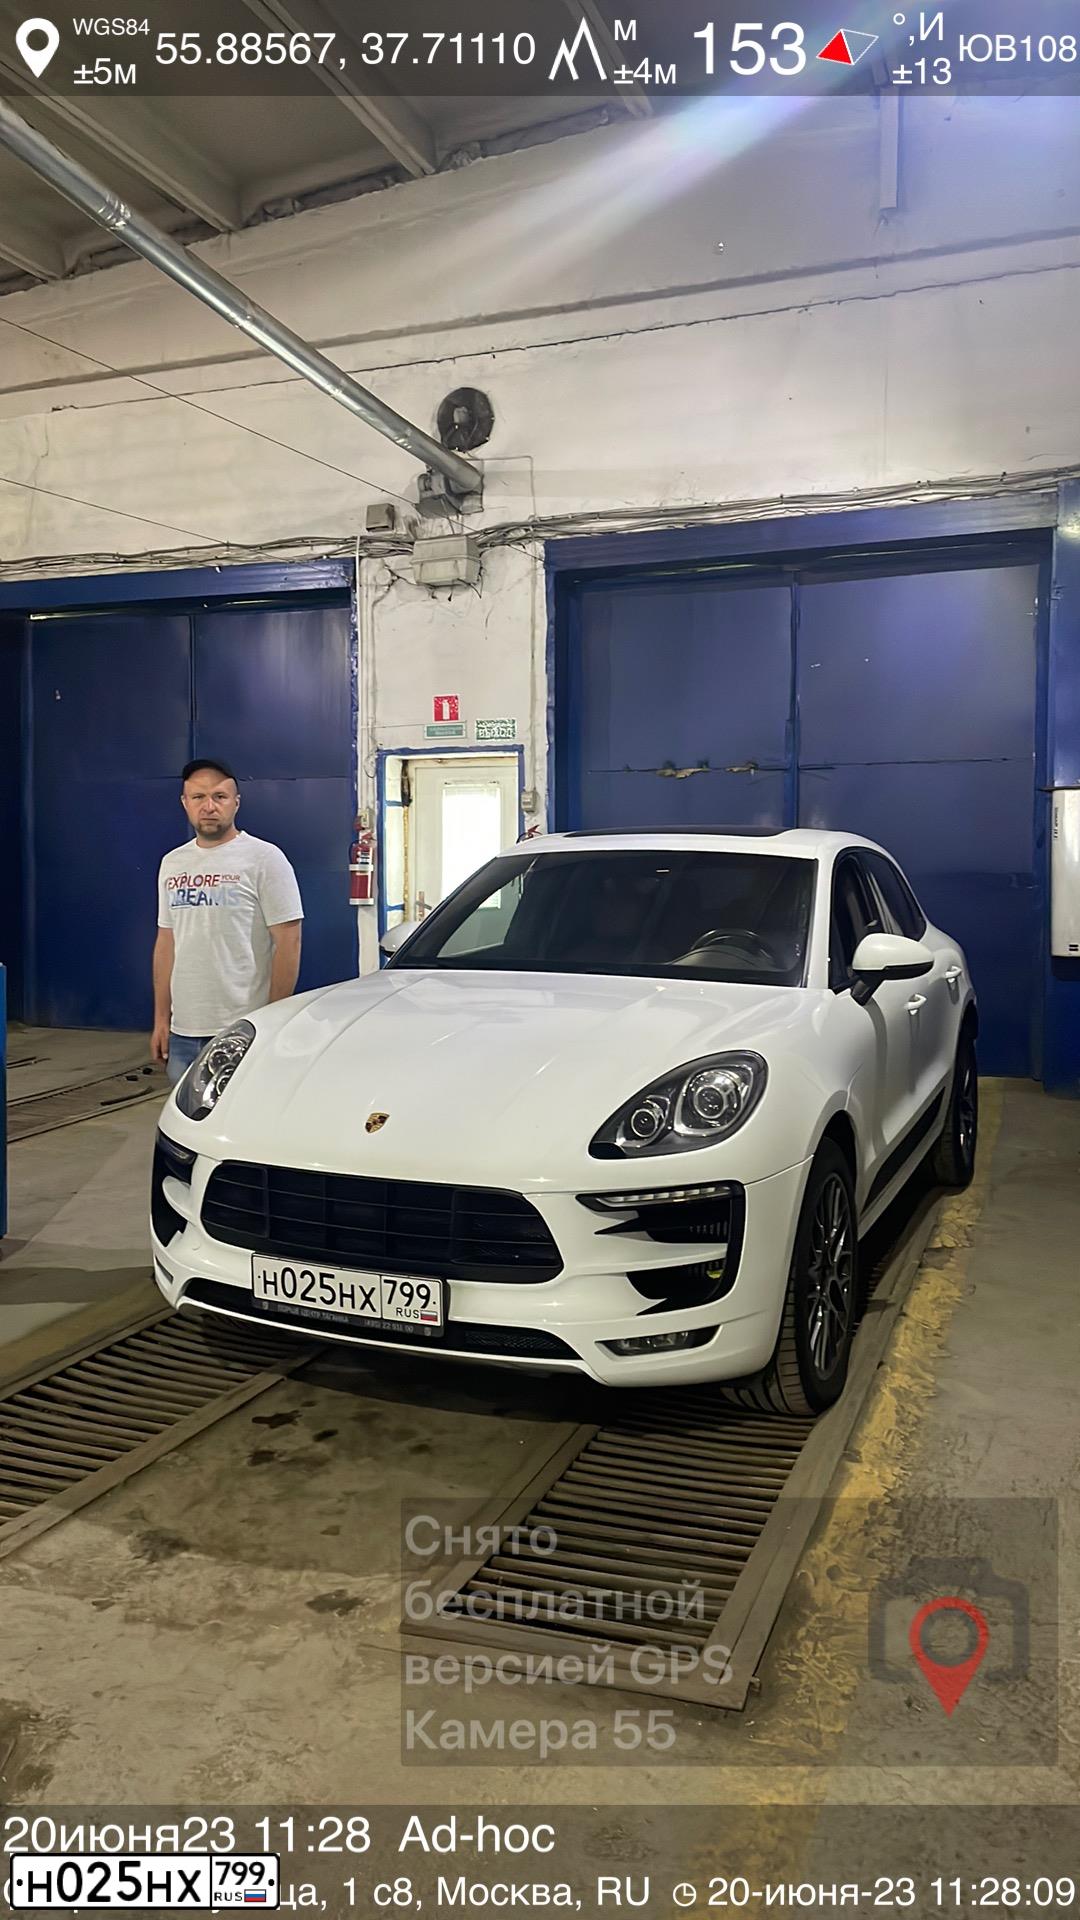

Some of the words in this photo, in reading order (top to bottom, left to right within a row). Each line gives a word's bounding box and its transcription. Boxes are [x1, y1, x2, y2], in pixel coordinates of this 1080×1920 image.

[168, 873, 220, 890] EXPLORE
[221, 873, 240, 881] YOUR
[383, 1279, 431, 1309] 799
[395, 1307, 420, 1319] RUS
